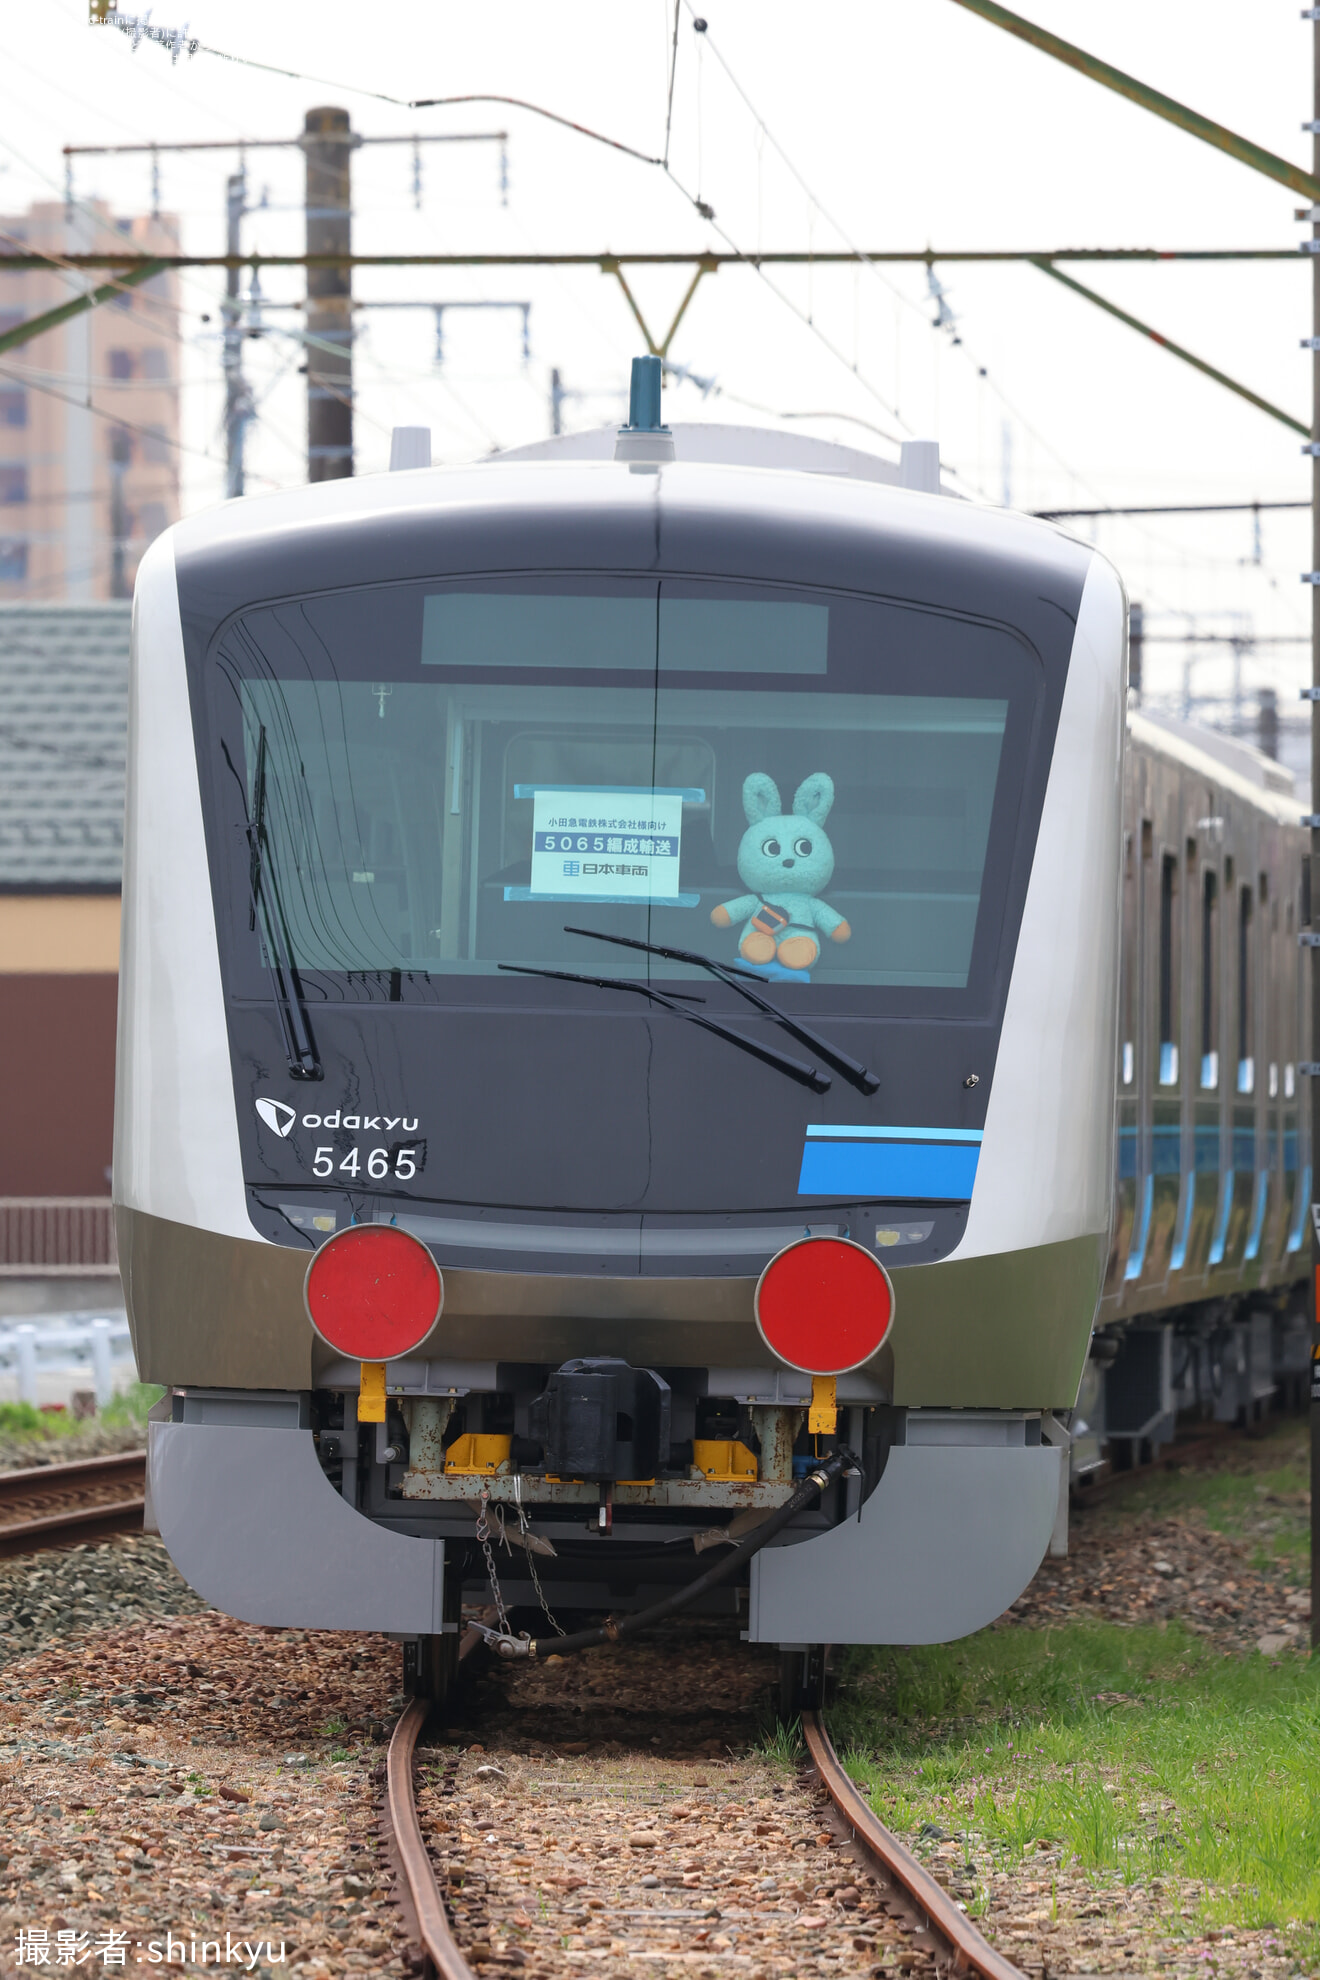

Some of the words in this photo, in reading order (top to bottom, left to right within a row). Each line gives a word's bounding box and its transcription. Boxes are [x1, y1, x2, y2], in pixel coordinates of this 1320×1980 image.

[548, 817, 667, 831] 小田急電鉄株式会社様向け
[544, 836, 672, 856] 5065編成輸送
[582, 863, 648, 876] 日本車両
[302, 1109, 419, 1132] odakyu
[312, 1146, 416, 1180] 5465
